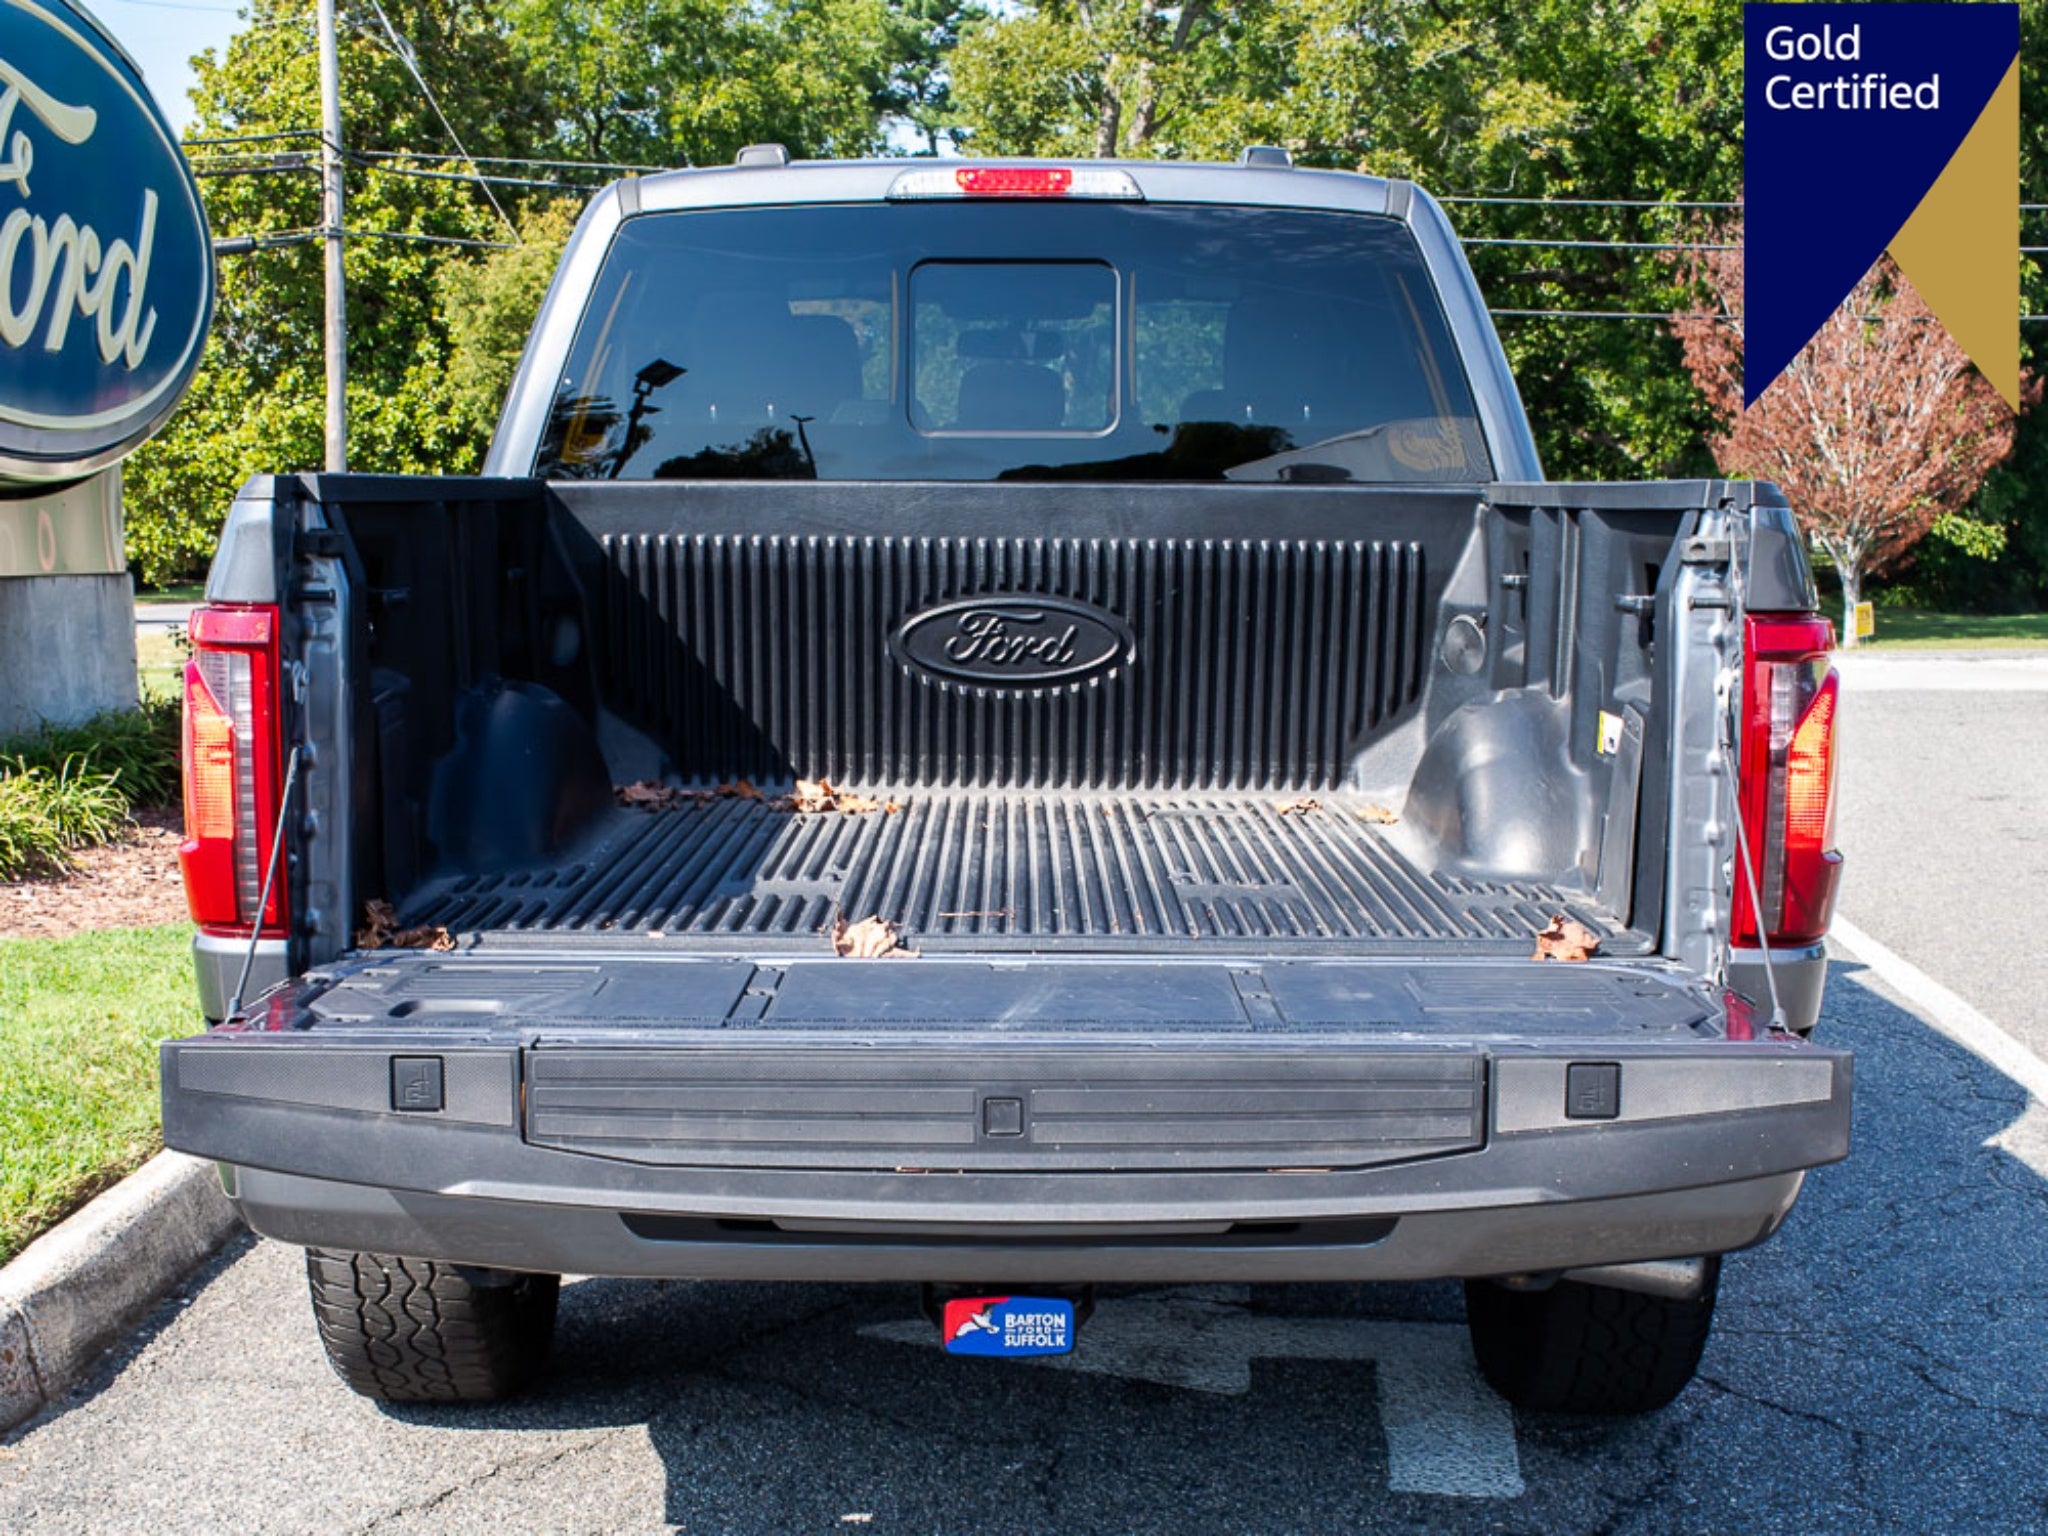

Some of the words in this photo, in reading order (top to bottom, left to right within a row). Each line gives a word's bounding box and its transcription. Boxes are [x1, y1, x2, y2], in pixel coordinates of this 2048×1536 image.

[944, 609, 1078, 664] Ford
[1004, 1313, 1066, 1328] BARTON
[1018, 1326, 1051, 1334] FORD
[1004, 1334, 1066, 1347] SUFFOLK
